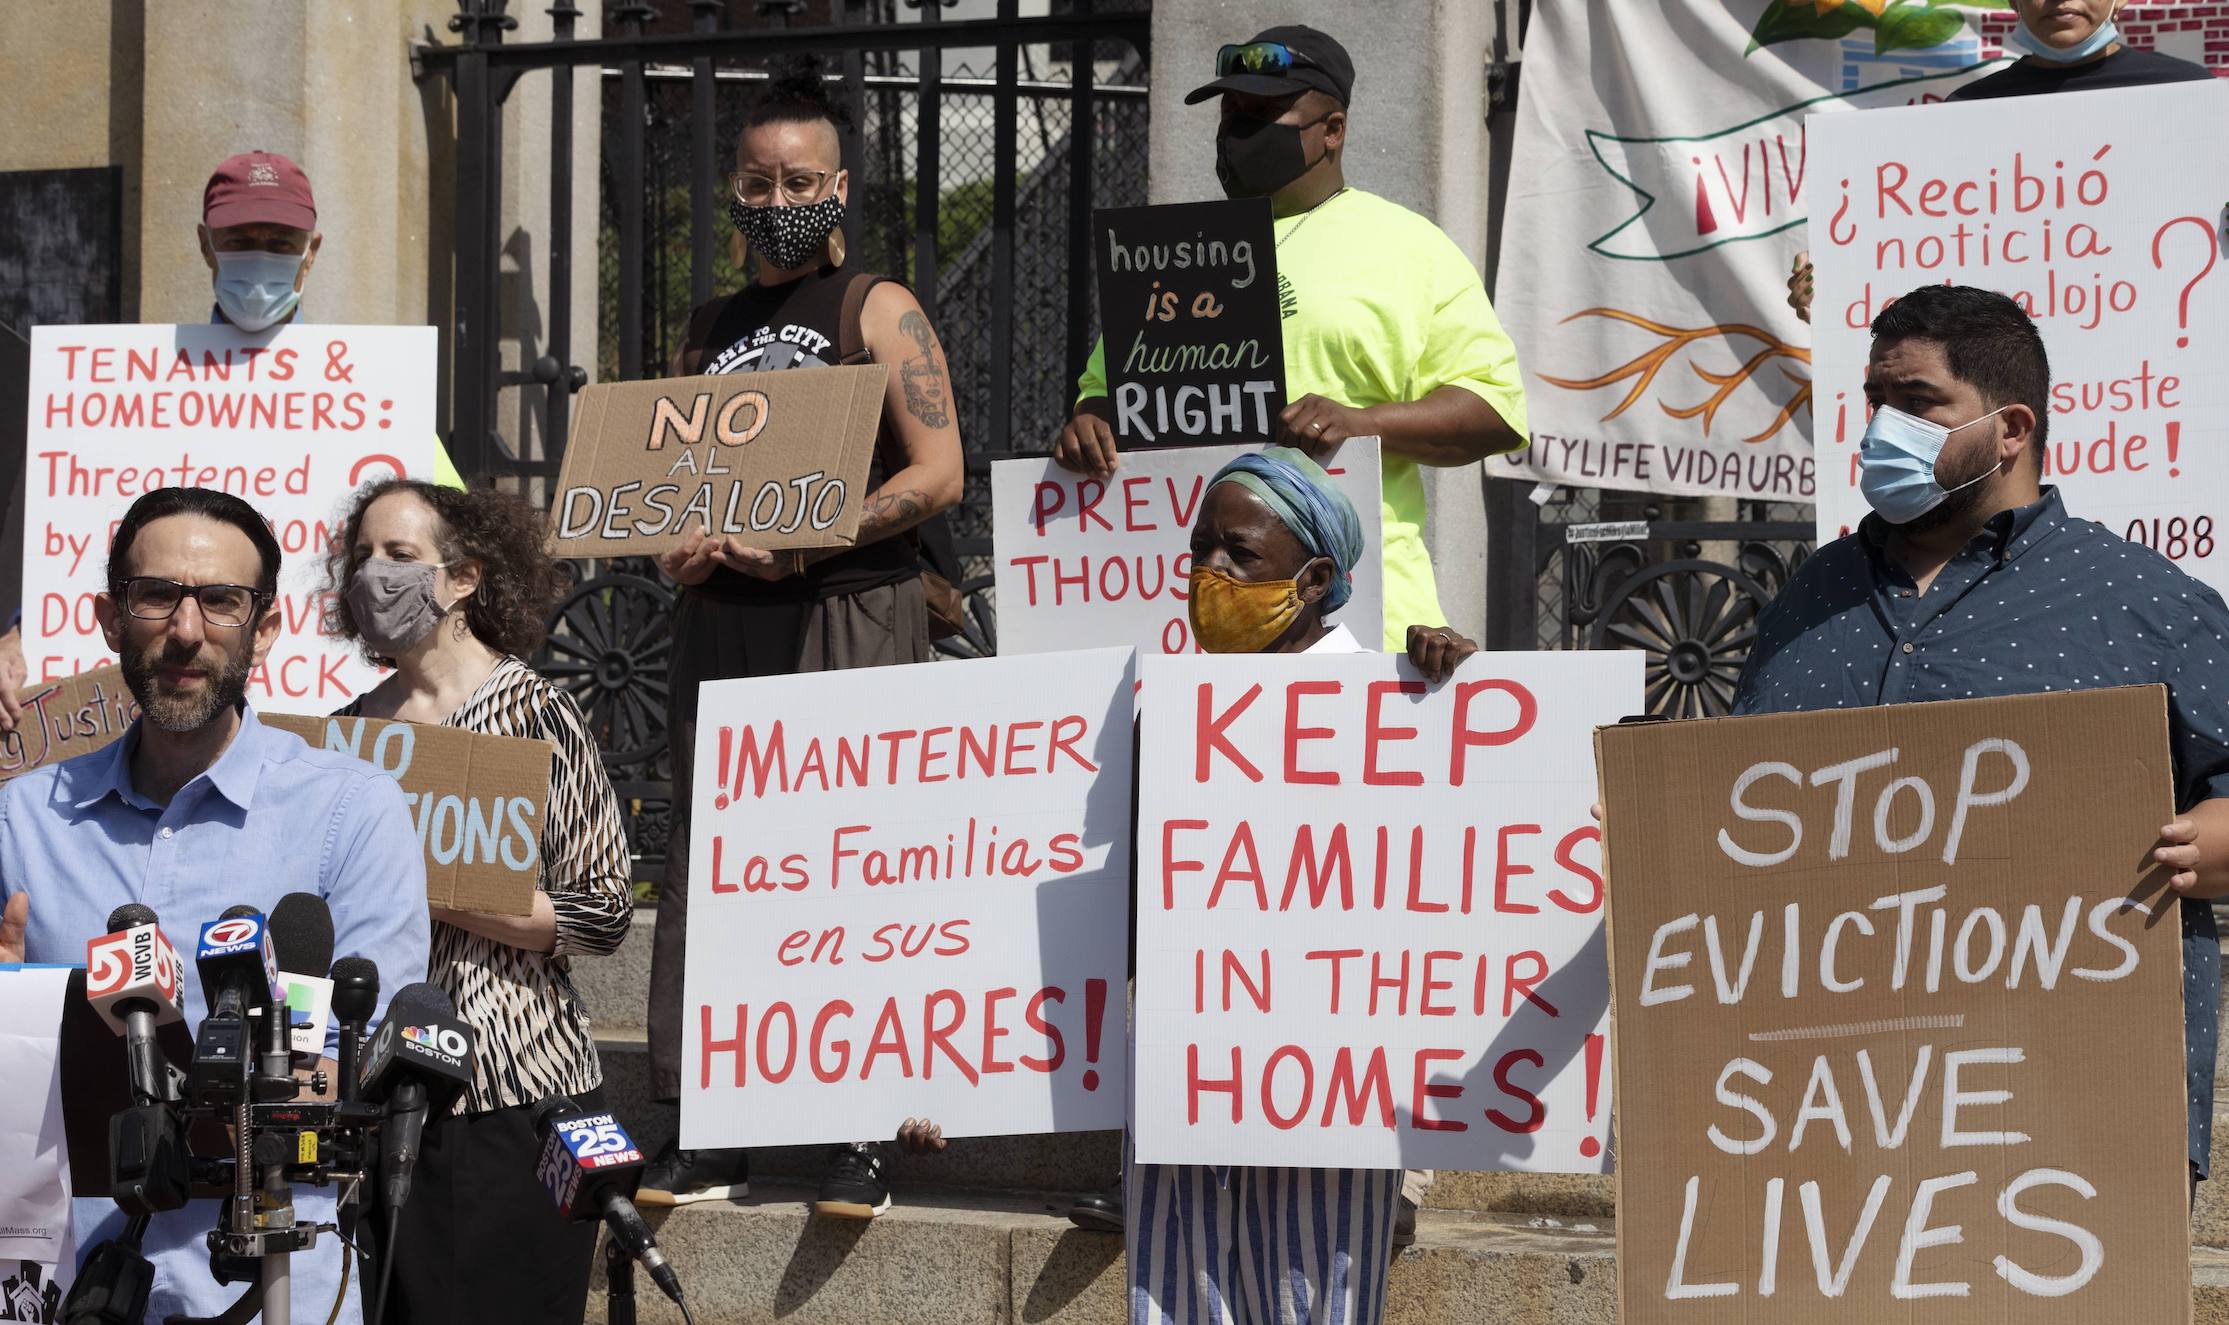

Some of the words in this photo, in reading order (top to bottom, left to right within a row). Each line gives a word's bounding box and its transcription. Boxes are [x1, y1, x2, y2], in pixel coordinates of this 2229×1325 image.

[1107, 228, 1257, 289] housing
[1875, 219, 2112, 271] noticia
[1145, 281, 1179, 322] is
[1192, 290, 1224, 320] a
[751, 332, 776, 347] THE
[755, 325, 770, 337] TO
[779, 324, 832, 355] CITY
[1122, 329, 1270, 374] human
[57, 346, 299, 383] TENANTS
[324, 340, 354, 383] &
[2047, 360, 2182, 414] suste
[45, 390, 395, 431] HOMEOWNERS:
[646, 389, 770, 451] NO
[1115, 380, 1277, 443] RIGHT
[38, 451, 311, 497] Threatened
[665, 445, 731, 479] AL
[558, 471, 847, 540] DESALOJO
[45, 521, 91, 578] by
[247, 653, 353, 698] ACK
[21, 681, 143, 768] Justic
[325, 717, 416, 782] NO
[1194, 678, 1538, 787] KEEP
[1716, 736, 2031, 868] STOP
[711, 834, 810, 894] Las
[831, 816, 1085, 890] Familias
[1162, 819, 1604, 915] FAMILIES
[135, 930, 151, 981] WCVB
[200, 941, 257, 958] NEWS
[777, 924, 846, 966] en
[862, 918, 971, 963] sus
[1638, 884, 2155, 1007] EVICTIONS
[1194, 948, 1272, 1015] IN
[1305, 948, 1561, 1018] THEIR
[405, 1041, 462, 1068] BOSTON
[424, 1024, 468, 1058] 10
[700, 977, 1108, 1093] HOGARES!
[1186, 1032, 1605, 1159] HOMES!
[1706, 1043, 2032, 1157] SAVE
[556, 1114, 614, 1133] BOSTON
[570, 1124, 628, 1158] 25
[593, 1149, 641, 1168] NEWS
[1664, 1167, 2105, 1300] LIVES
